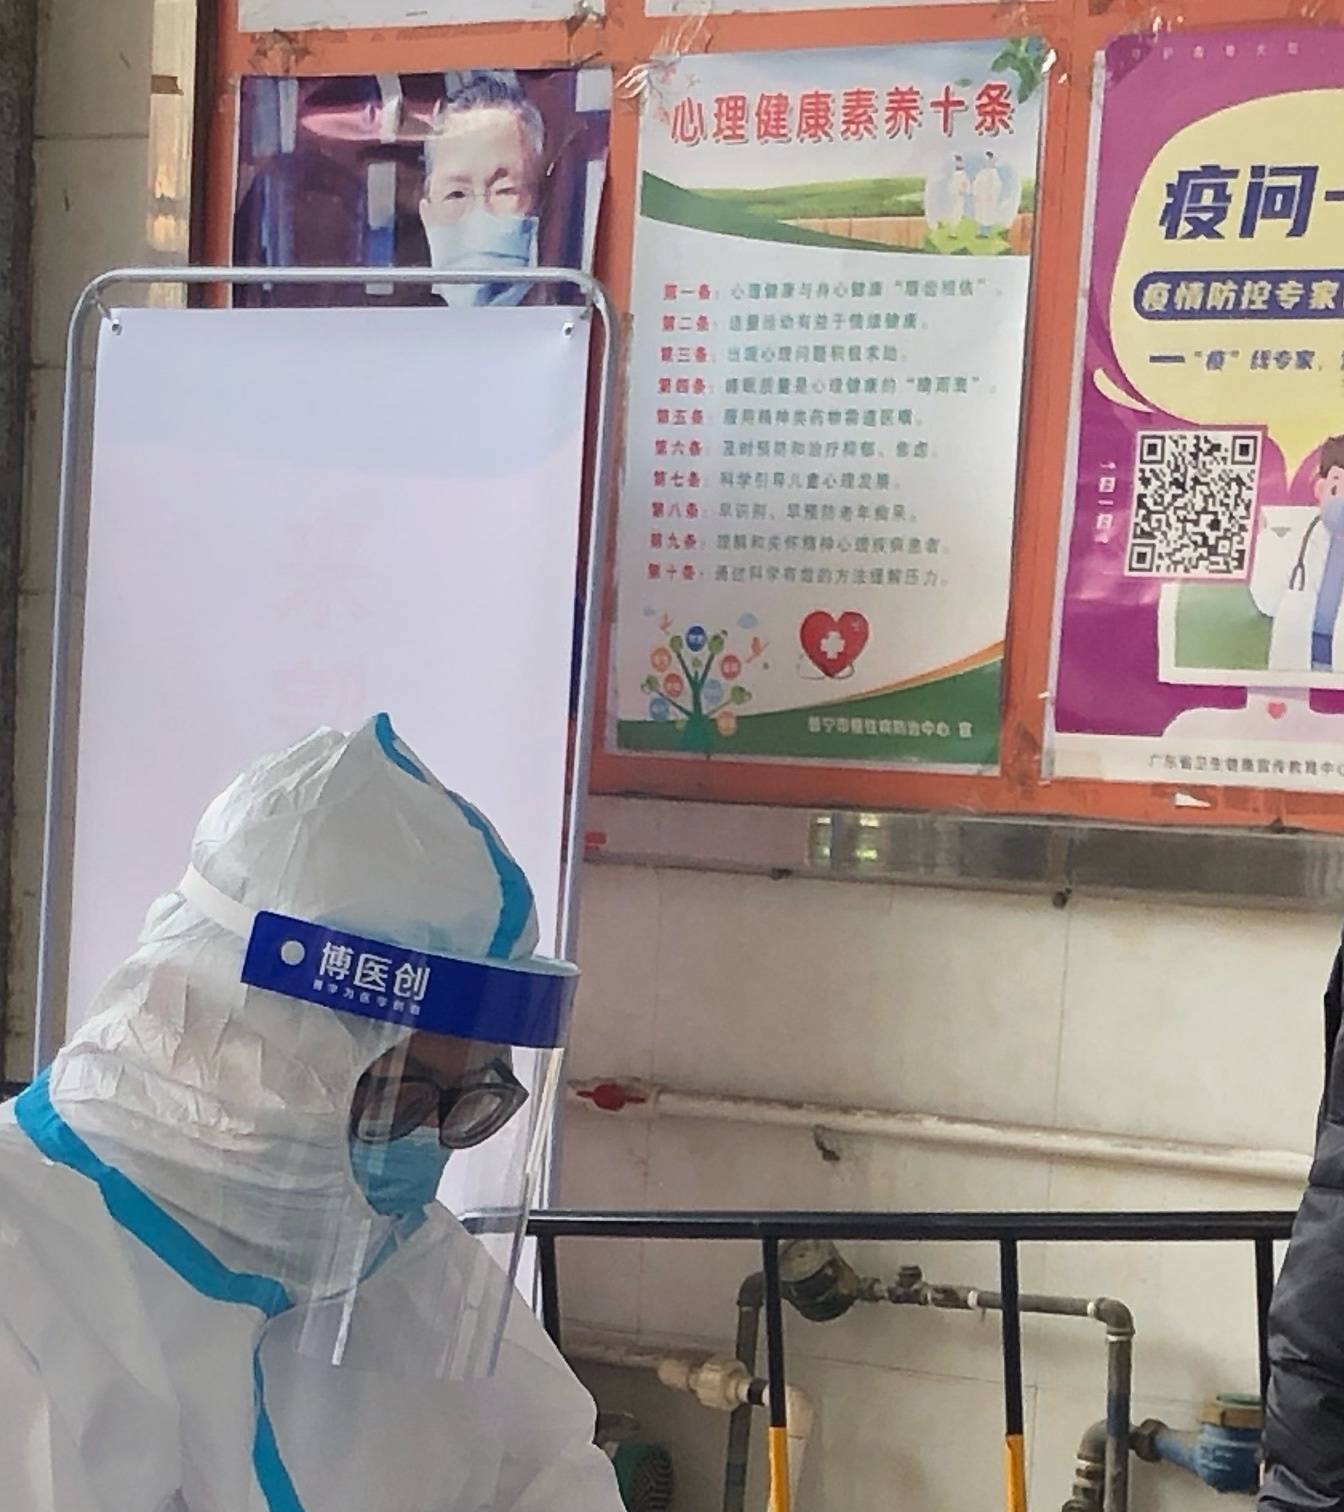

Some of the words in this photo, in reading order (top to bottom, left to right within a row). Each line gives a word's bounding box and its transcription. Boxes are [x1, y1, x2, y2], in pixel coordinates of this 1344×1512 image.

[670, 82, 1013, 144] 心理健康素养十条
[318, 941, 431, 1002] 博医创
